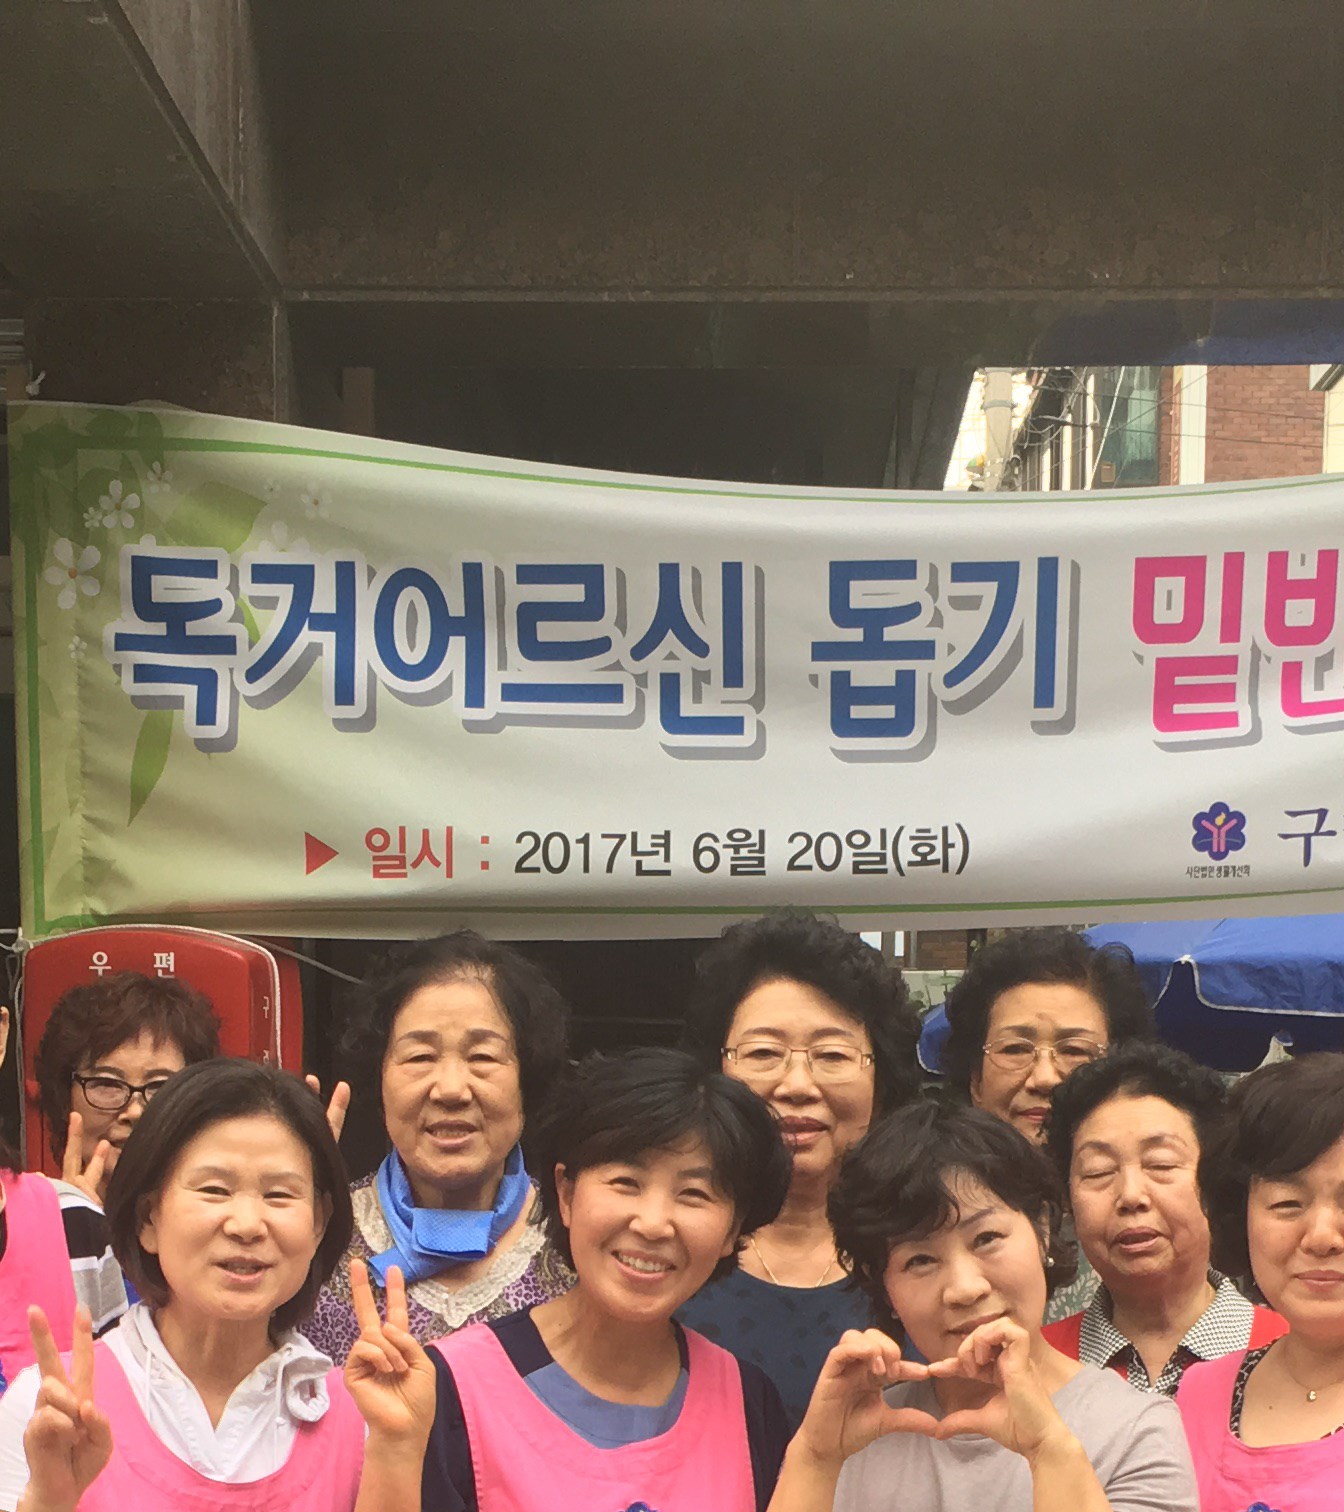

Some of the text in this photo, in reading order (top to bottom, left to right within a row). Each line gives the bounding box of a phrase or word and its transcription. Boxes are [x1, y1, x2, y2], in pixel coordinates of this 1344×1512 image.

[114, 555, 751, 736] 독거어르신
[811, 557, 1060, 738] 돕기
[364, 826, 454, 879] 일시
[514, 829, 673, 877] 2017년
[692, 828, 768, 877] 6월
[786, 827, 972, 878] 20일(화)
